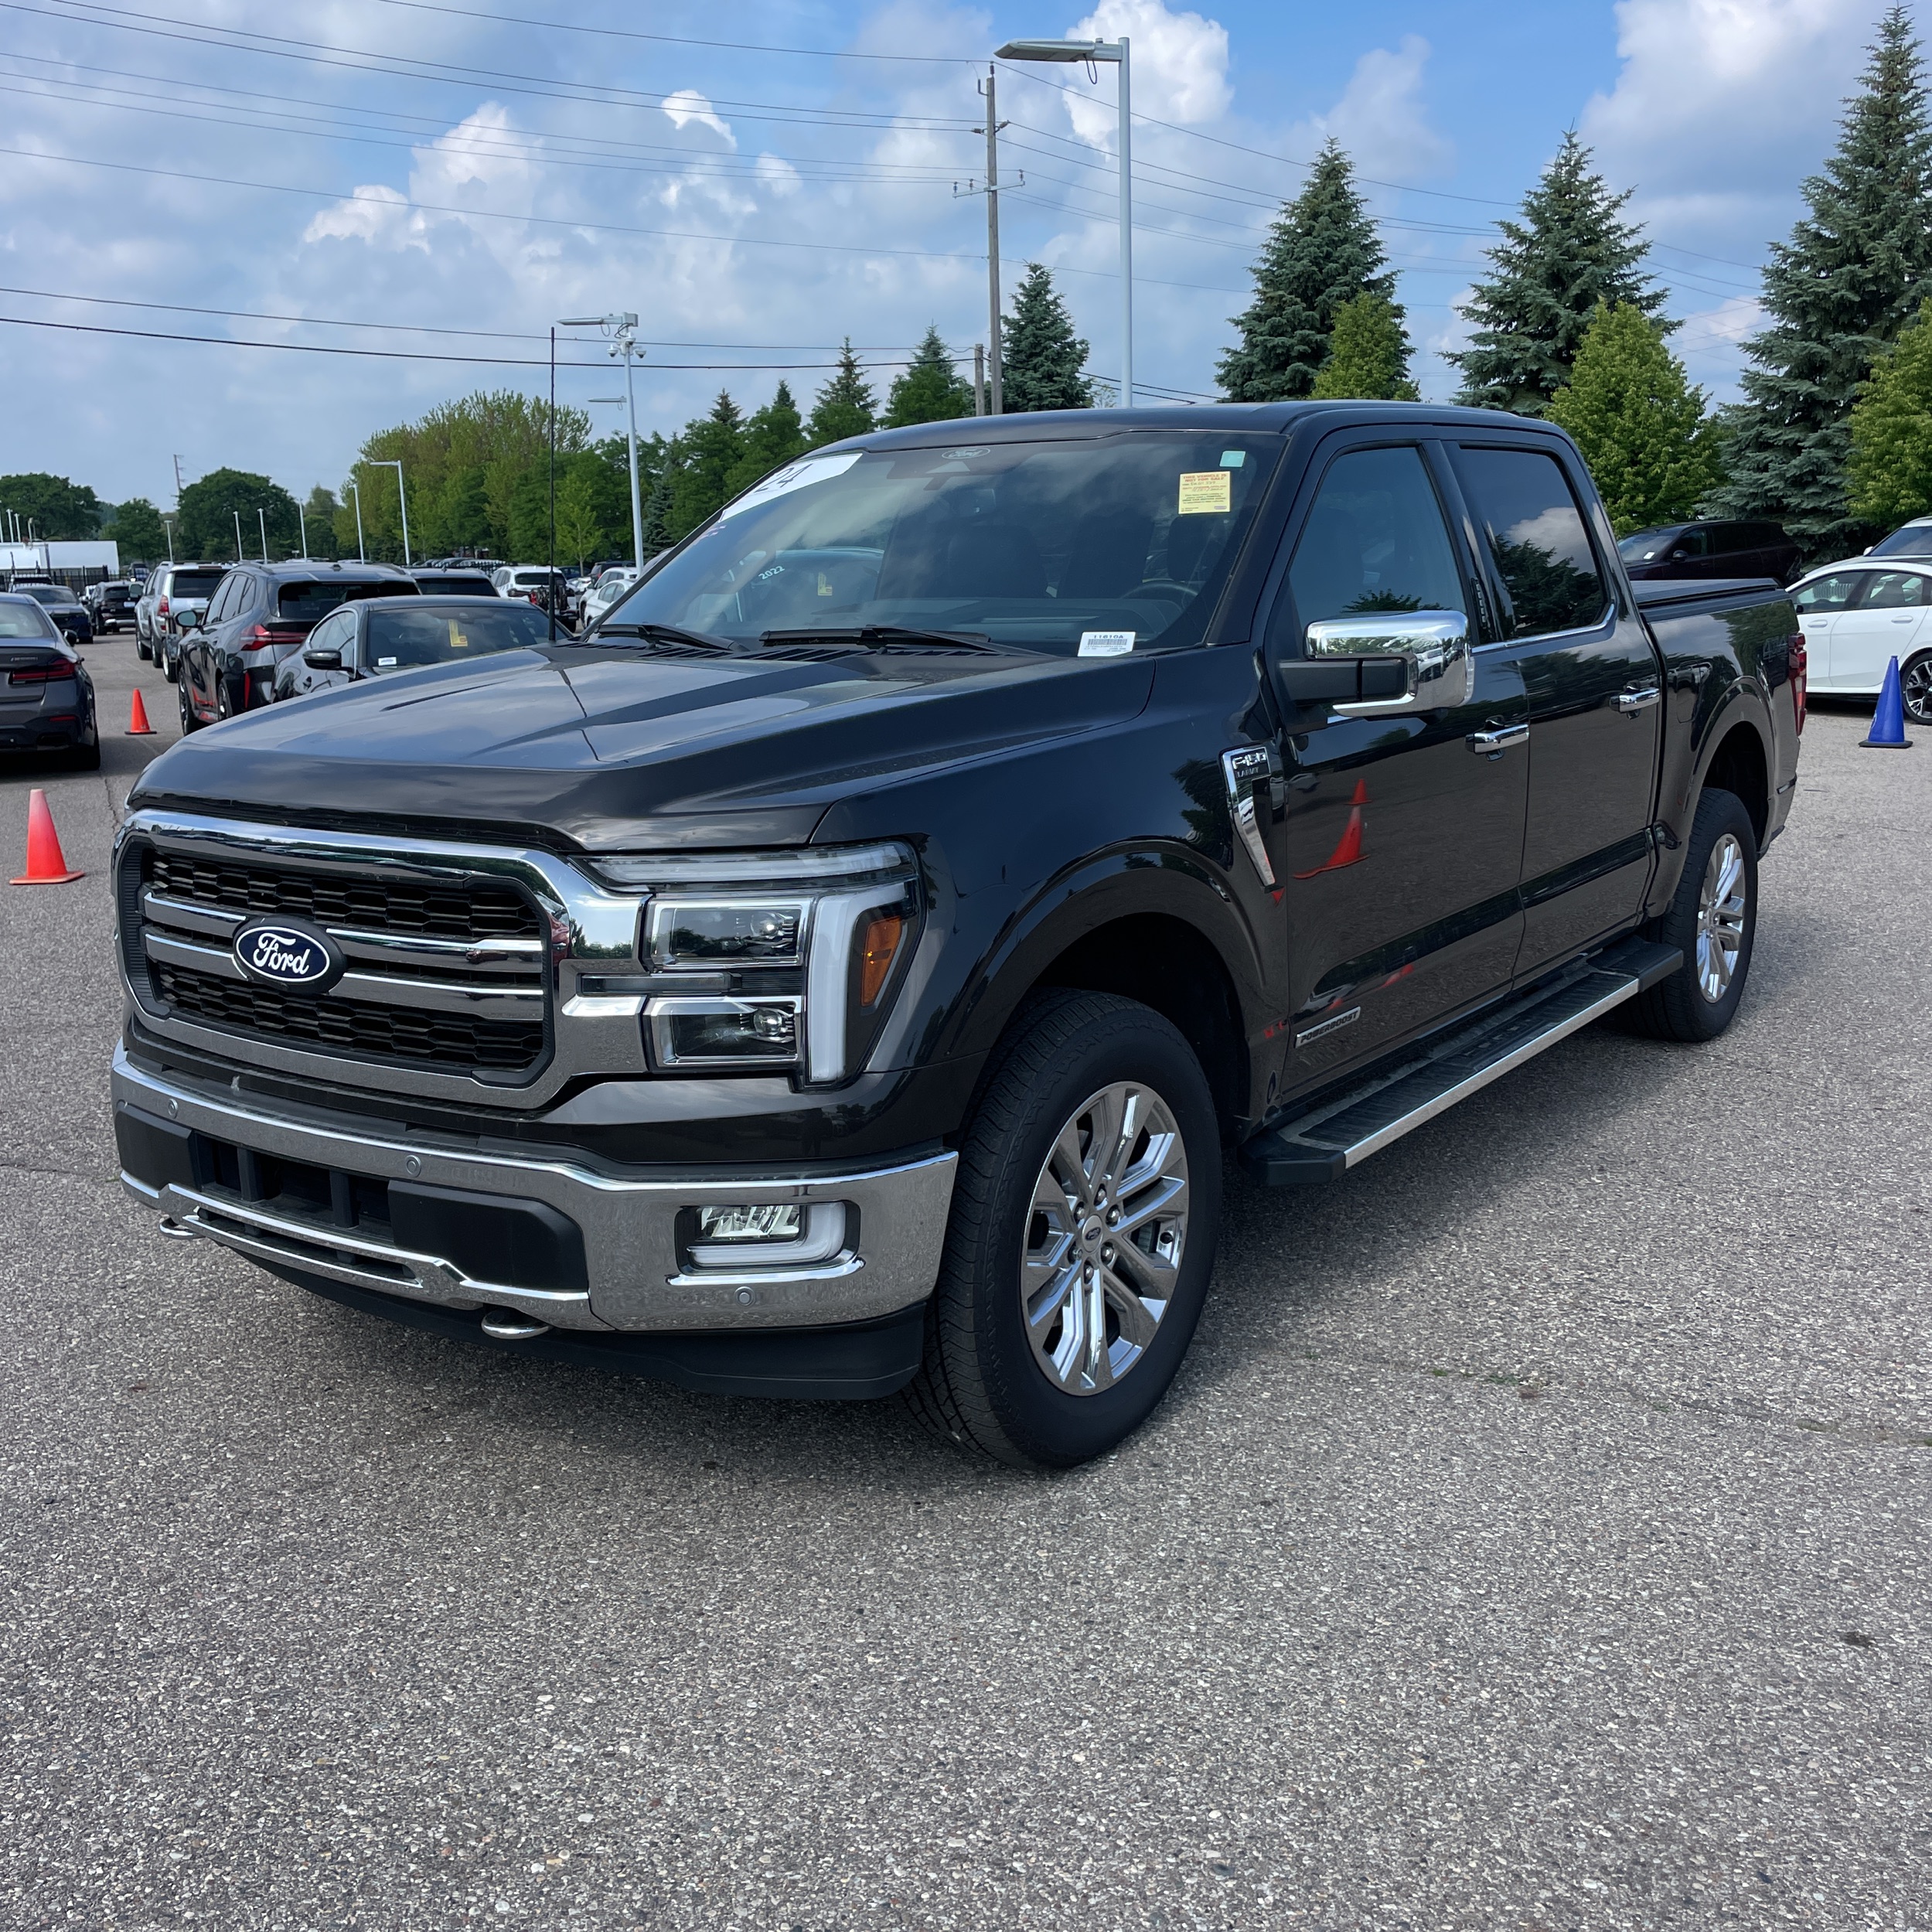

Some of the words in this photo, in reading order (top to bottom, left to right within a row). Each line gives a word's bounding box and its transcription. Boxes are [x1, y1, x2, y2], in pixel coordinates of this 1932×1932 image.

[758, 565, 785, 580] 2022
[253, 932, 311, 975] Ford
[1300, 1010, 1358, 1044] POWERBOOST
